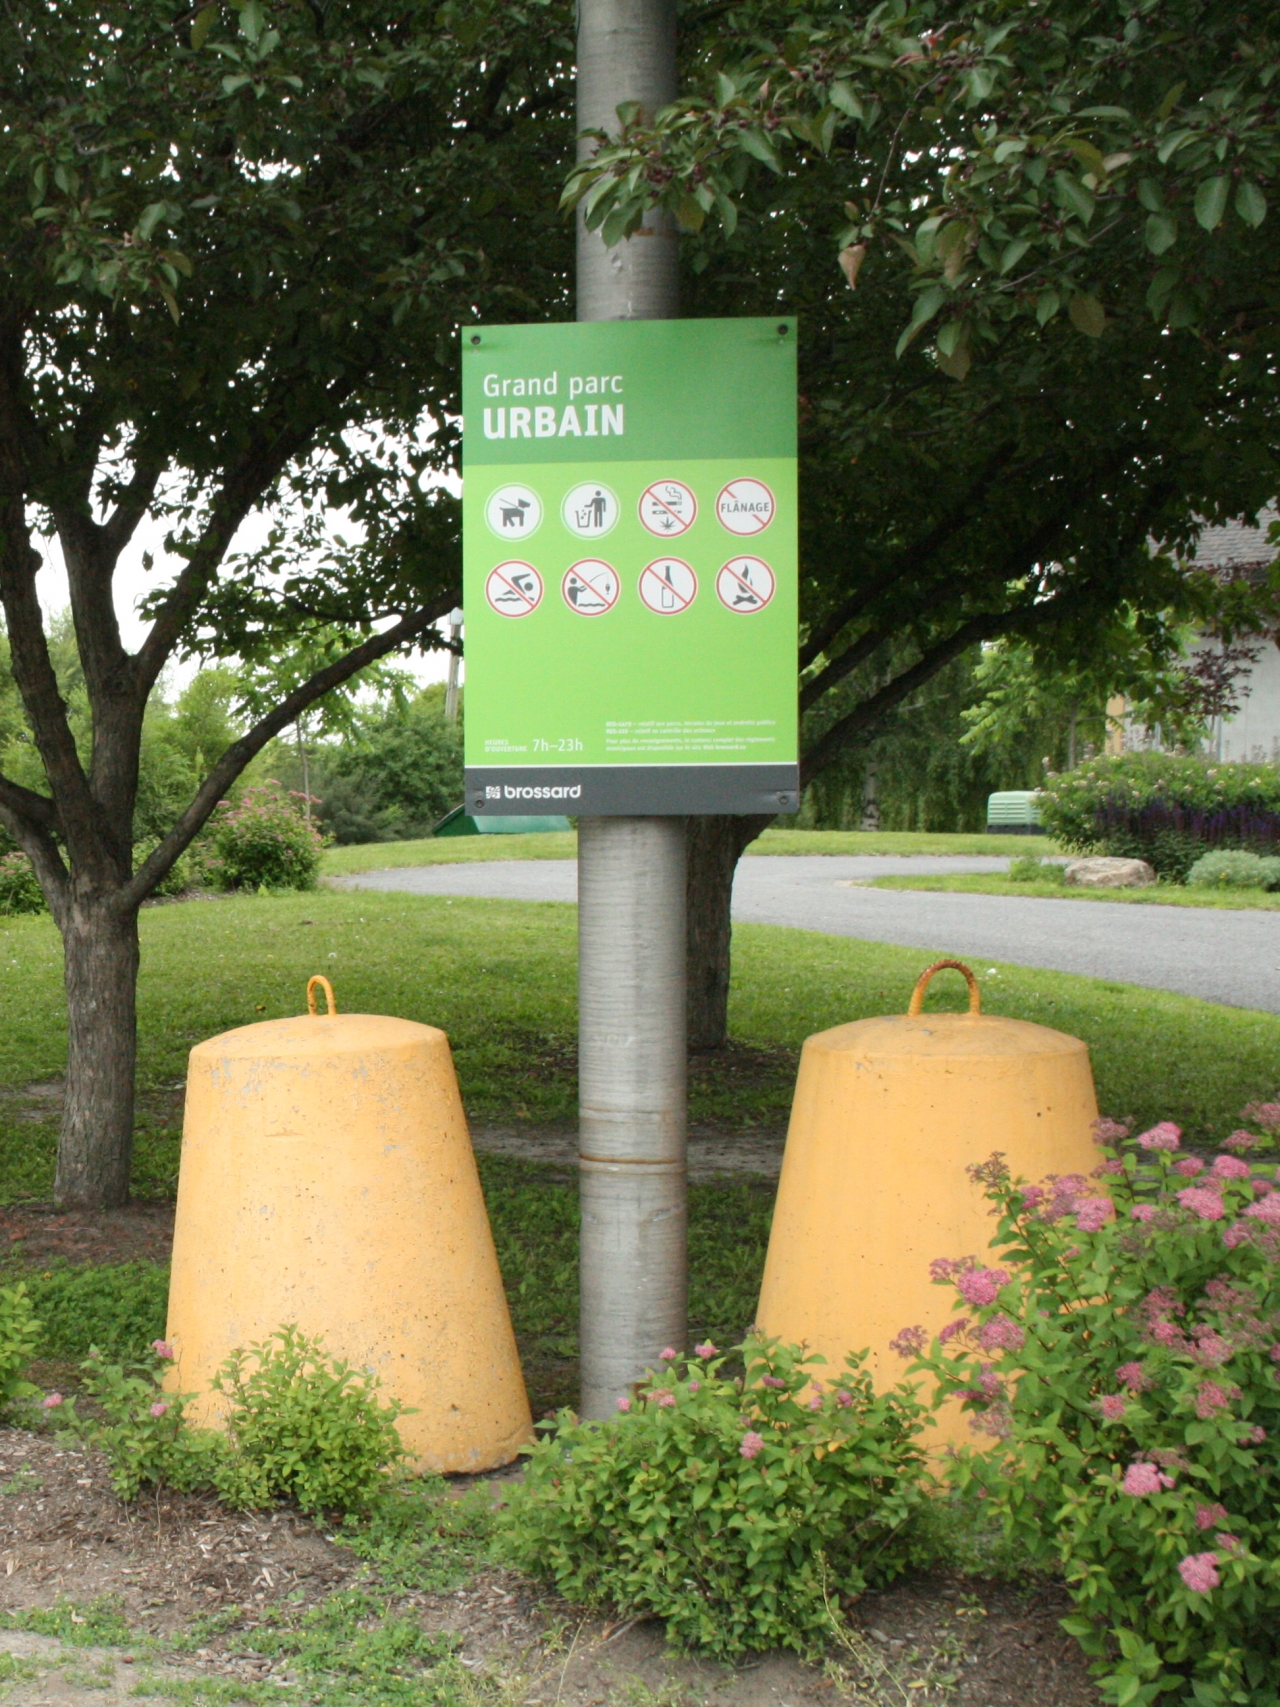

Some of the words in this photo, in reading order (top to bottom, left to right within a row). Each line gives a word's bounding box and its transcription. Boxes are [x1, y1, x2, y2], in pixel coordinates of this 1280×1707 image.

[483, 371, 558, 397] Grand
[569, 374, 624, 401] parc
[483, 403, 625, 440] URBAIN
[720, 498, 771, 514] FLÂNAGE
[505, 784, 581, 799] brossard
